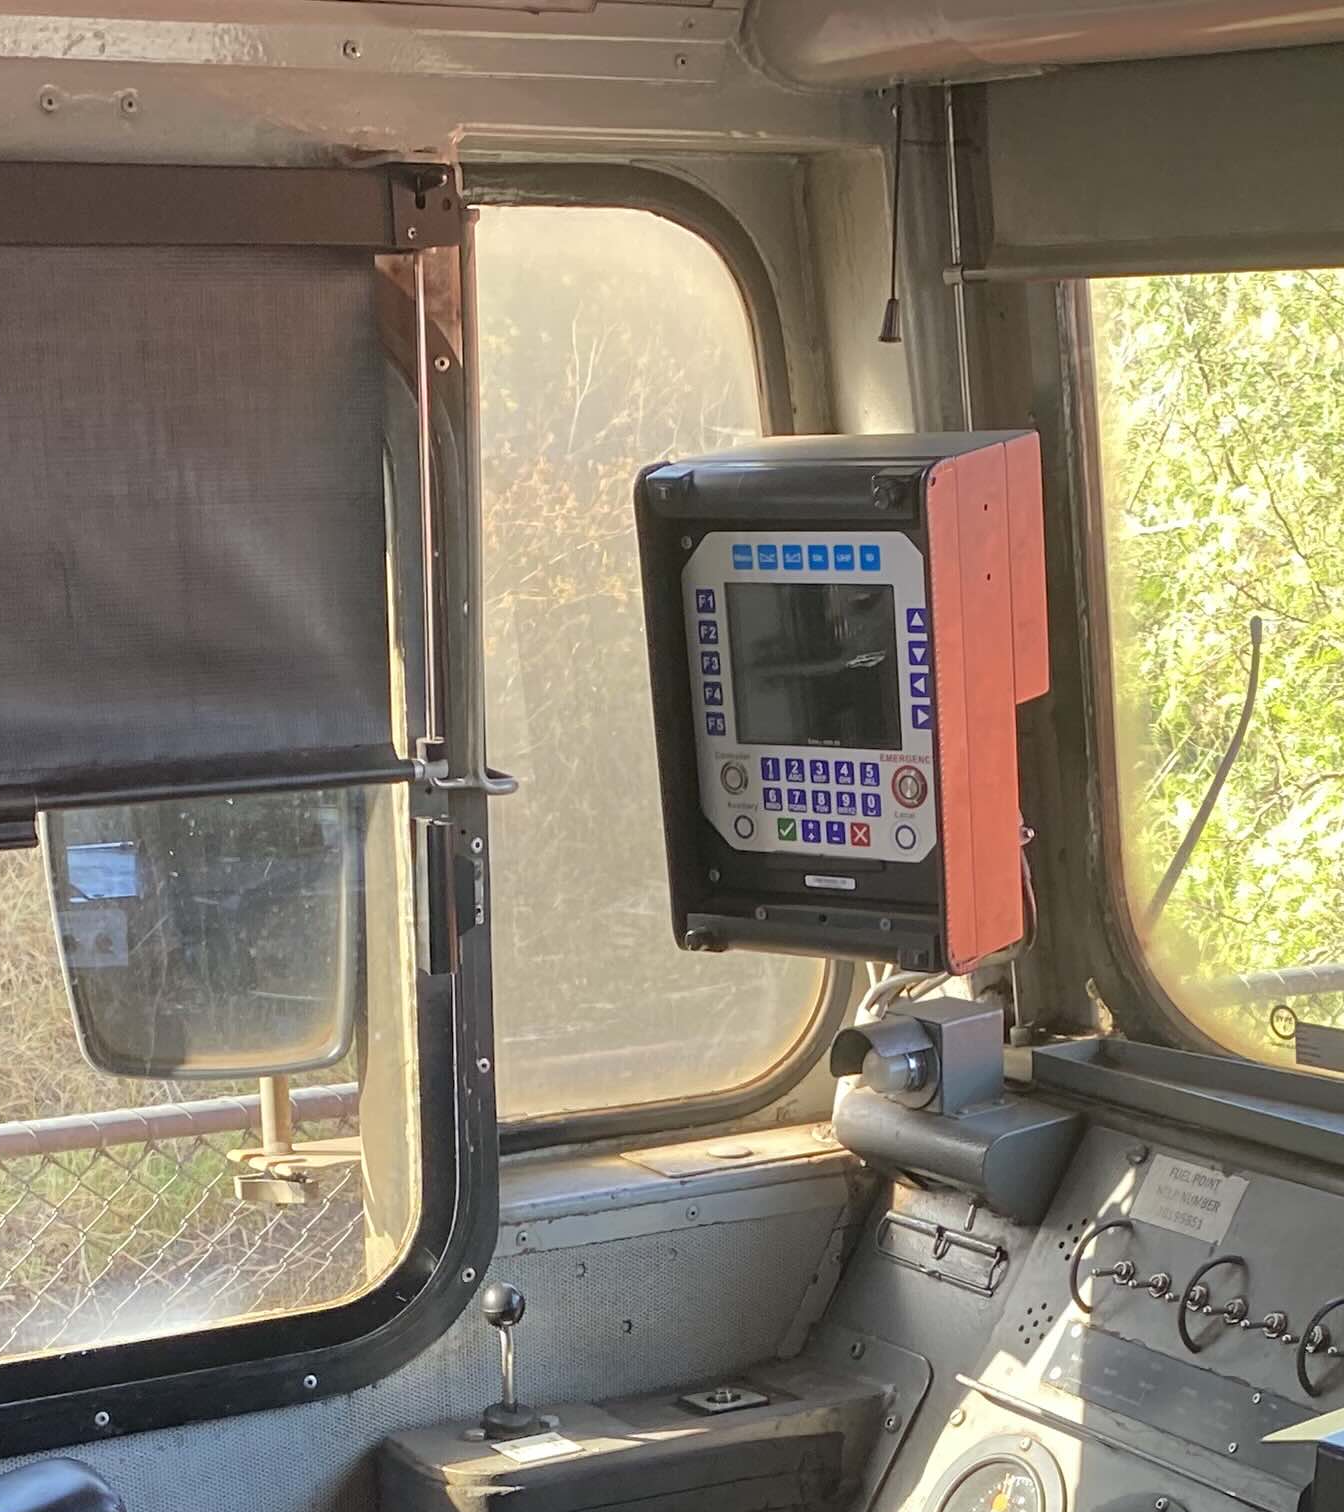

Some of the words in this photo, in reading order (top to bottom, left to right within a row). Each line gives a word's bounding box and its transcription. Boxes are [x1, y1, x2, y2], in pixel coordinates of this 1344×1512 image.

[698, 594, 714, 607] F1
[700, 626, 716, 639] F2
[703, 657, 719, 670] F3
[706, 687, 721, 700] F4
[708, 717, 724, 731] F5
[791, 761, 798, 774] 2
[816, 762, 823, 775] 3
[840, 763, 849, 776] 4
[866, 764, 874, 777] 5
[769, 789, 776, 802] 6
[792, 790, 800, 804] 7
[818, 792, 825, 805] 8
[842, 794, 850, 807] 9
[867, 795, 875, 808] 0
[1169, 1167, 1191, 1183] FUEL
[1192, 1175, 1222, 1191] POINT
[1181, 1191, 1221, 1213] NUMBER
